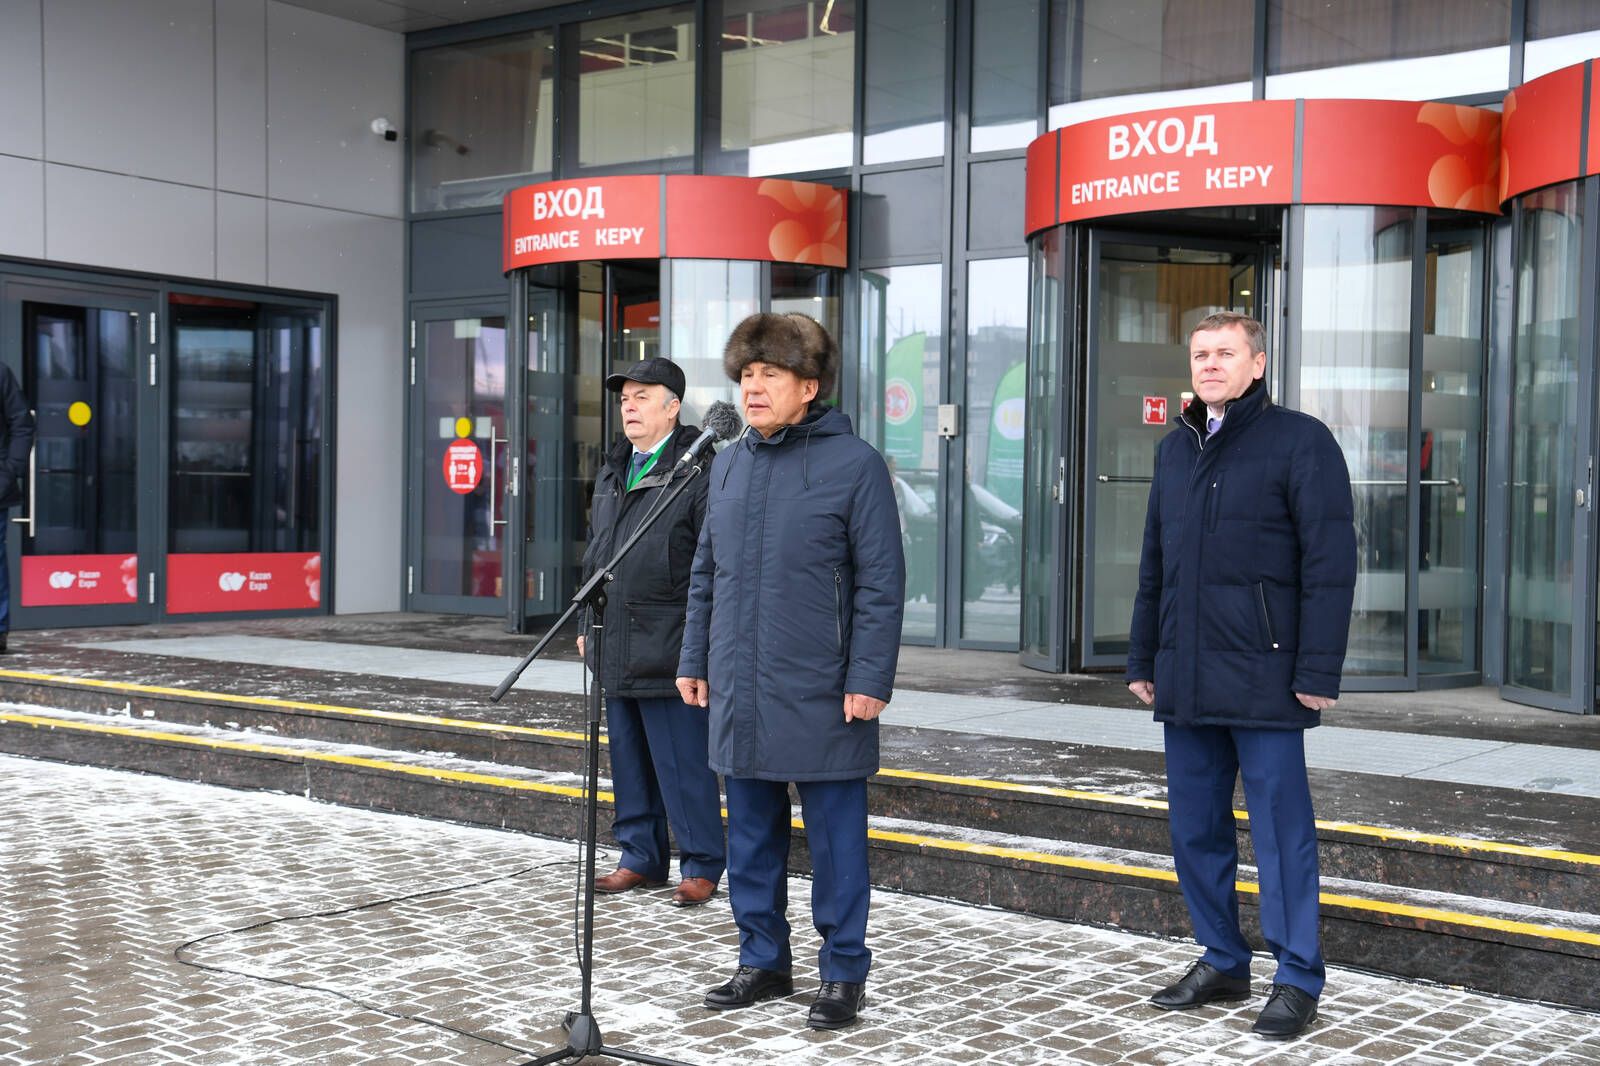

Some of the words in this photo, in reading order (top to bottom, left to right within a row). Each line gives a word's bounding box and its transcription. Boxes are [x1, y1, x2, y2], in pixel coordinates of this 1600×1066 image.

[1108, 114, 1219, 160] ВХОД
[1071, 171, 1181, 205] ENTRANCE
[1205, 165, 1274, 190] КЕРУ
[533, 186, 605, 221] ВХОД
[514, 230, 580, 255] ENTRANCE
[595, 227, 645, 246] КЕРУ
